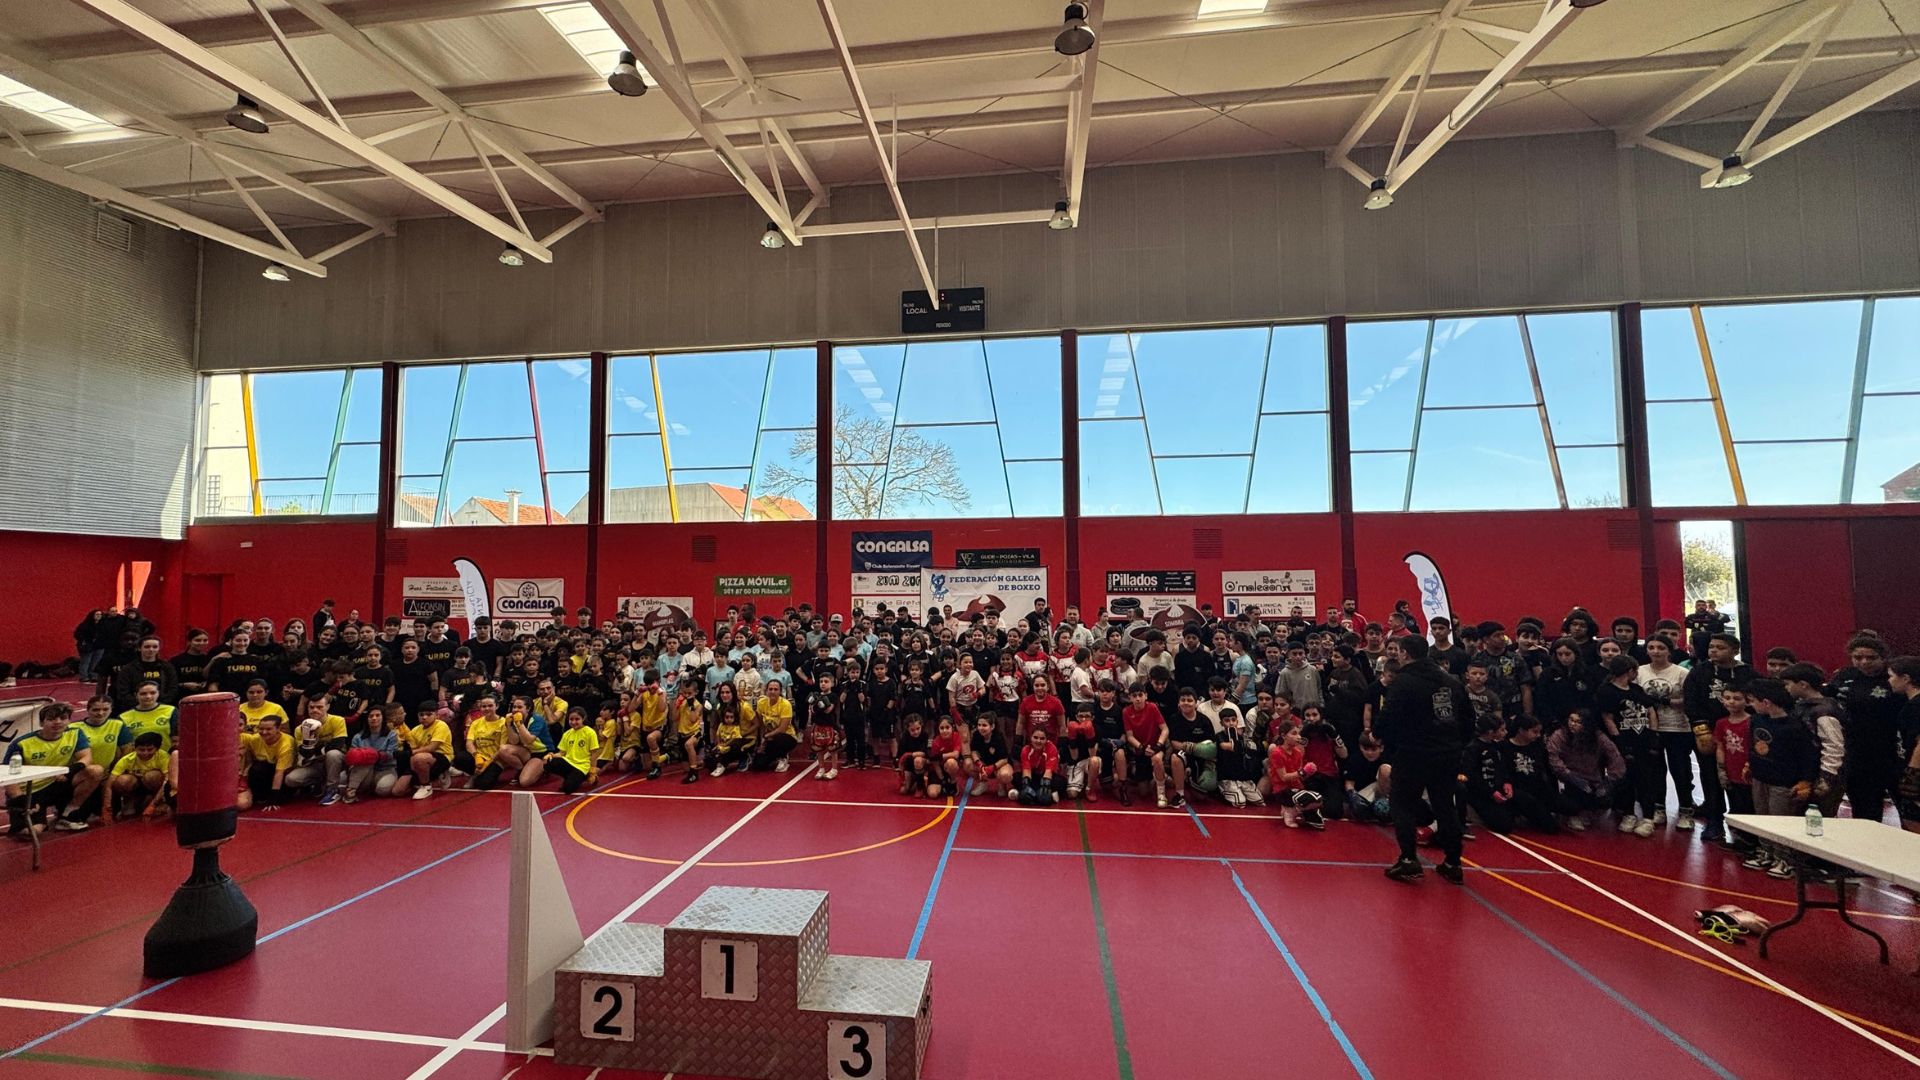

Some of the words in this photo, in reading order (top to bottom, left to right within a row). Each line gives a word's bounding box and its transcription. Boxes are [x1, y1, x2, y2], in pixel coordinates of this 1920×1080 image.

[856, 540, 930, 553] CONGALSA
[719, 577, 745, 586] PIZZA
[747, 575, 787, 586] MÓVIL.es
[876, 575, 899, 586] ZUM
[949, 574, 1004, 583] FEDERACIÓN
[1112, 573, 1158, 586] Pillados
[502, 599, 555, 609] CONGALSA
[227, 665, 257, 673] TURBO
[31, 752, 47, 760] SK
[719, 944, 735, 994] 1
[592, 985, 624, 1036] 2
[839, 1025, 873, 1078] 3
